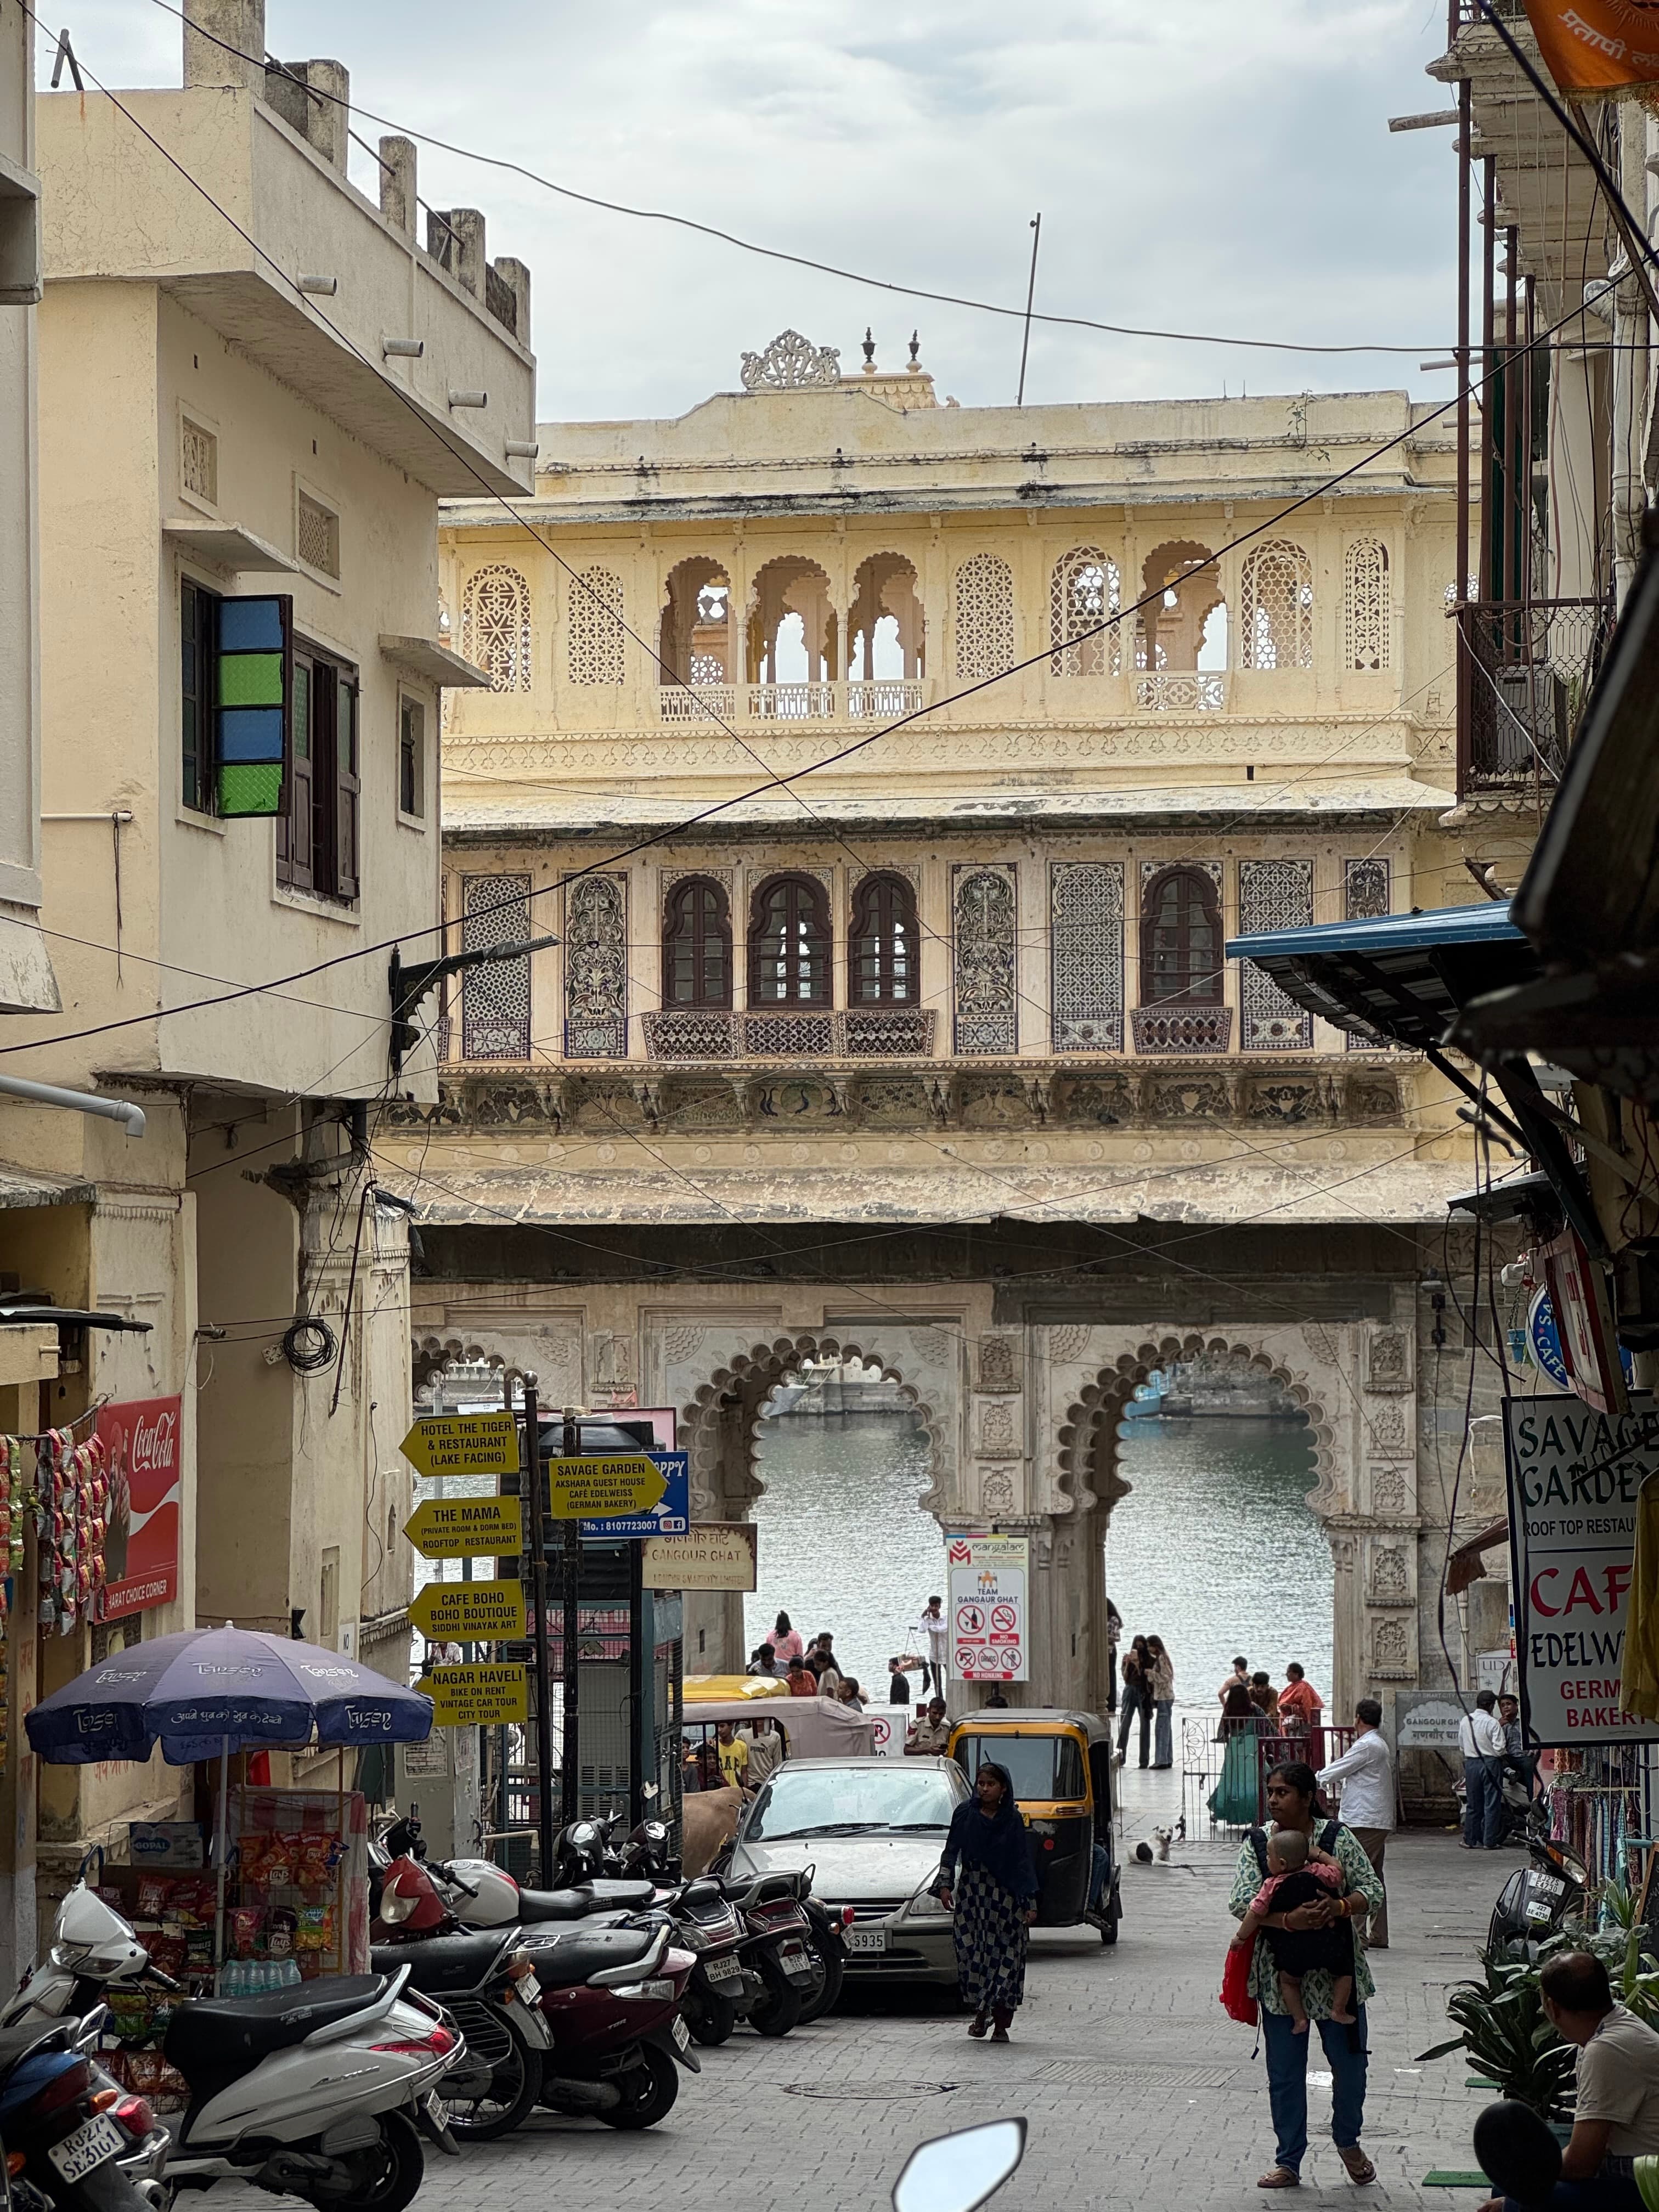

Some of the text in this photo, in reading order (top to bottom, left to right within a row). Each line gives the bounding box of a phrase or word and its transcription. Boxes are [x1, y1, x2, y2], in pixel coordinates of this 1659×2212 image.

[1537, 1336, 1565, 1377] CAFE
[421, 1421, 511, 1435] HOTEL THE TIGER
[132, 1411, 176, 1472] Coca-Cola
[428, 1436, 507, 1450] & RESTAURANT
[431, 1452, 506, 1468] (LAKE FACING)
[557, 1463, 645, 1476] SAVAGE GARDEN
[556, 1477, 645, 1488] AKSHARA GUEST HOUSE
[569, 1489, 633, 1498] CAFÉ EDELWEISS
[567, 1499, 636, 1511] (GERMAN BAKERY)
[433, 1507, 500, 1522] THE MAMA
[421, 1526, 449, 1536] (PRIVATE
[606, 1521, 657, 1531] 8107723007
[1525, 1517, 1636, 1536] ROOF TOP RESTAU
[423, 1535, 516, 1549] ROOFTOP RESTAURANT
[972, 1539, 1024, 1553] mangalam
[652, 1549, 741, 1561] GANGOUR GHAT
[126, 1585, 145, 1604] CHOICE
[146, 1579, 167, 1598] CORNER
[1531, 1565, 1634, 1617] CAF
[442, 1592, 504, 1606] CAFE BOHO
[431, 1606, 517, 1621] BOHO BOUTIQUE
[432, 1620, 517, 1632] SIDDHI VINAYAK ART
[343, 1634, 349, 1650] NO
[1531, 1629, 1626, 1667] EDELW
[1482, 1660, 1506, 1671] UD
[433, 1670, 522, 1685] NAGAR HAVELI
[451, 1686, 506, 1696] BIKE ON RENT
[1561, 1679, 1621, 1700] GERM
[441, 1698, 517, 1708] VINTAGE CAR TOUR
[459, 1710, 500, 1719] CITY TOUR
[135, 1842, 167, 1850] GOPAL
[1537, 1872, 1559, 1886] RJ27S
[1536, 1881, 1558, 1893] E4730
[713, 1959, 731, 1971] RJ27
[709, 1966, 740, 1981] BH 9829
